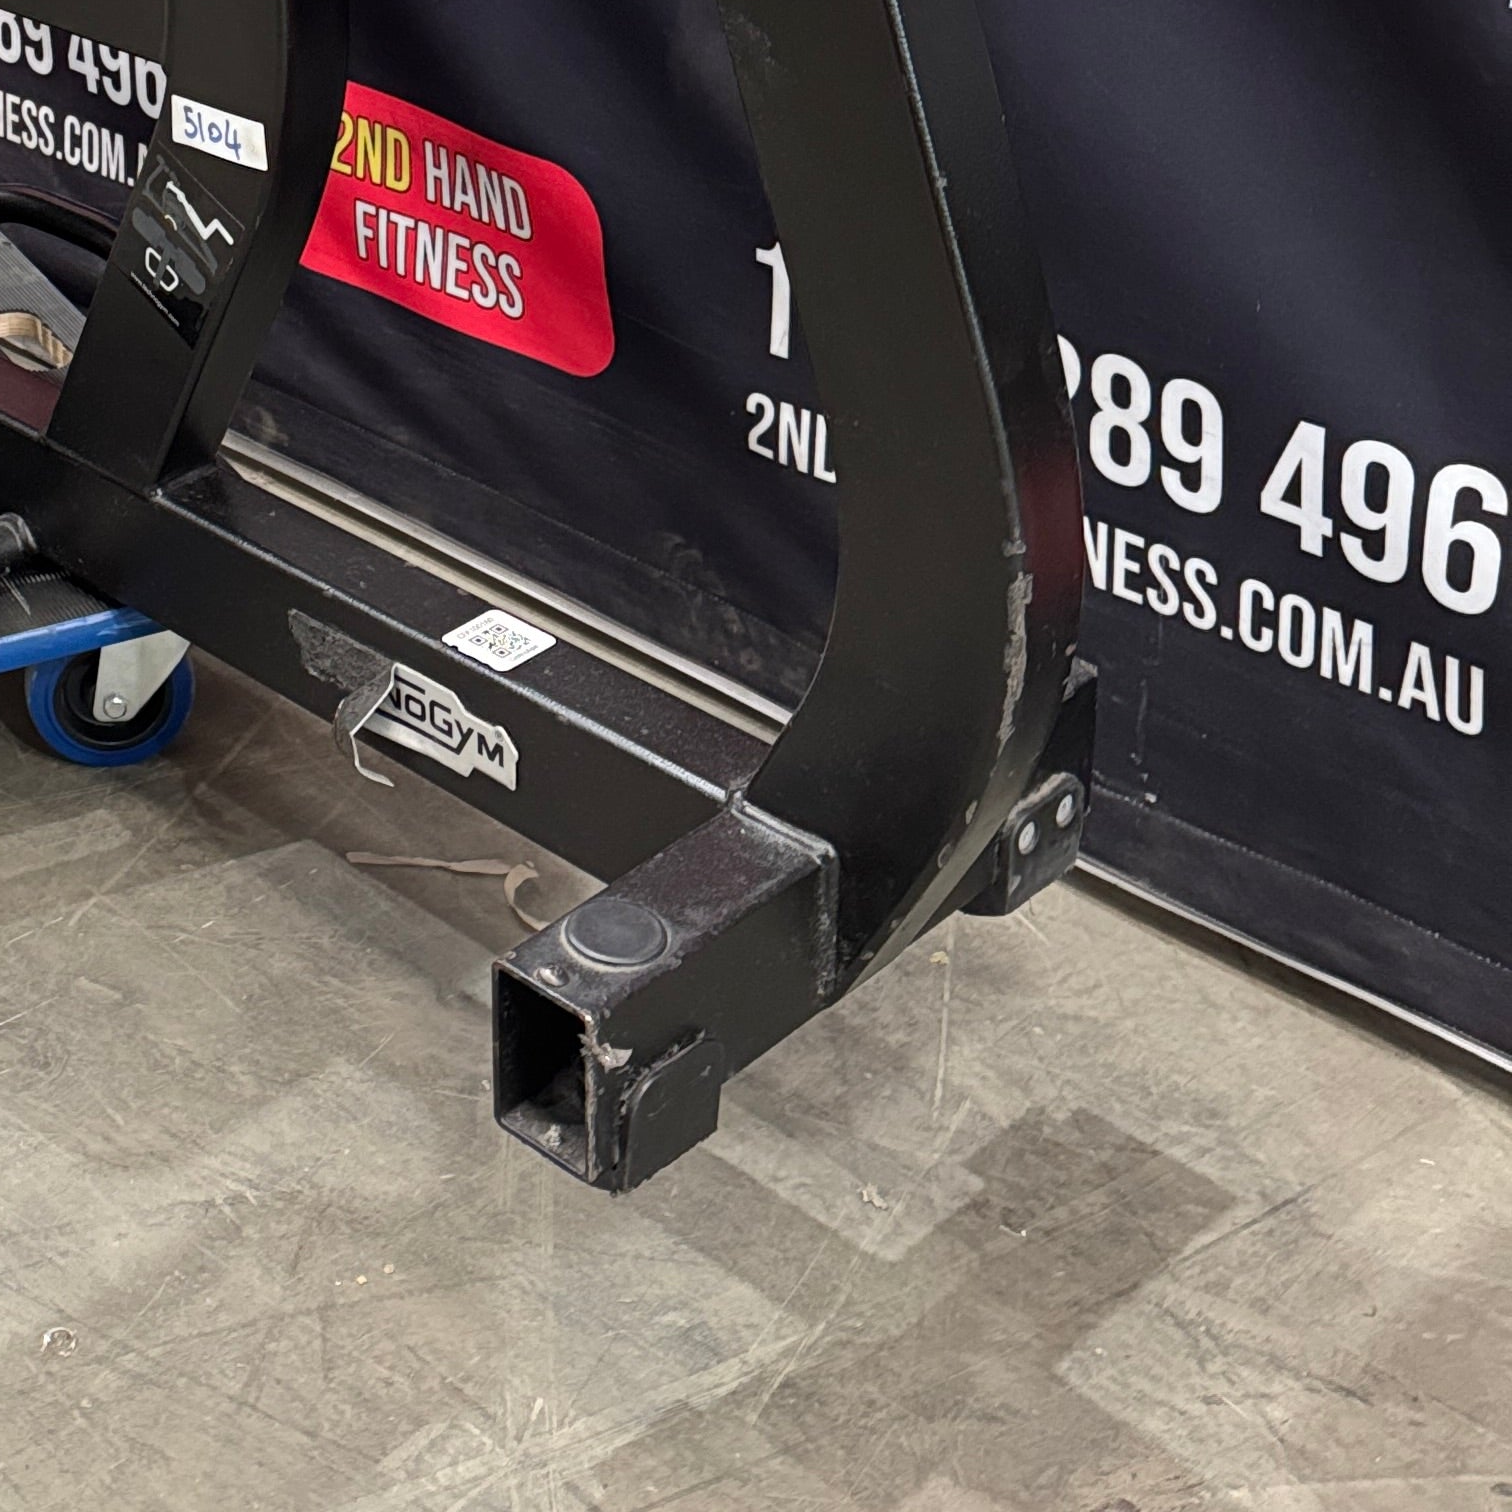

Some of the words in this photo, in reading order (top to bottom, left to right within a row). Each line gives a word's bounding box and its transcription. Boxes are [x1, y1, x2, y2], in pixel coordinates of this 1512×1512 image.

[183, 105, 241, 161] 5104
[331, 113, 409, 190] 2ND
[426, 142, 530, 238] HAND
[356, 201, 522, 317] FITNESS
[1057, 335, 1222, 513] 89
[1261, 421, 1508, 614] 496
